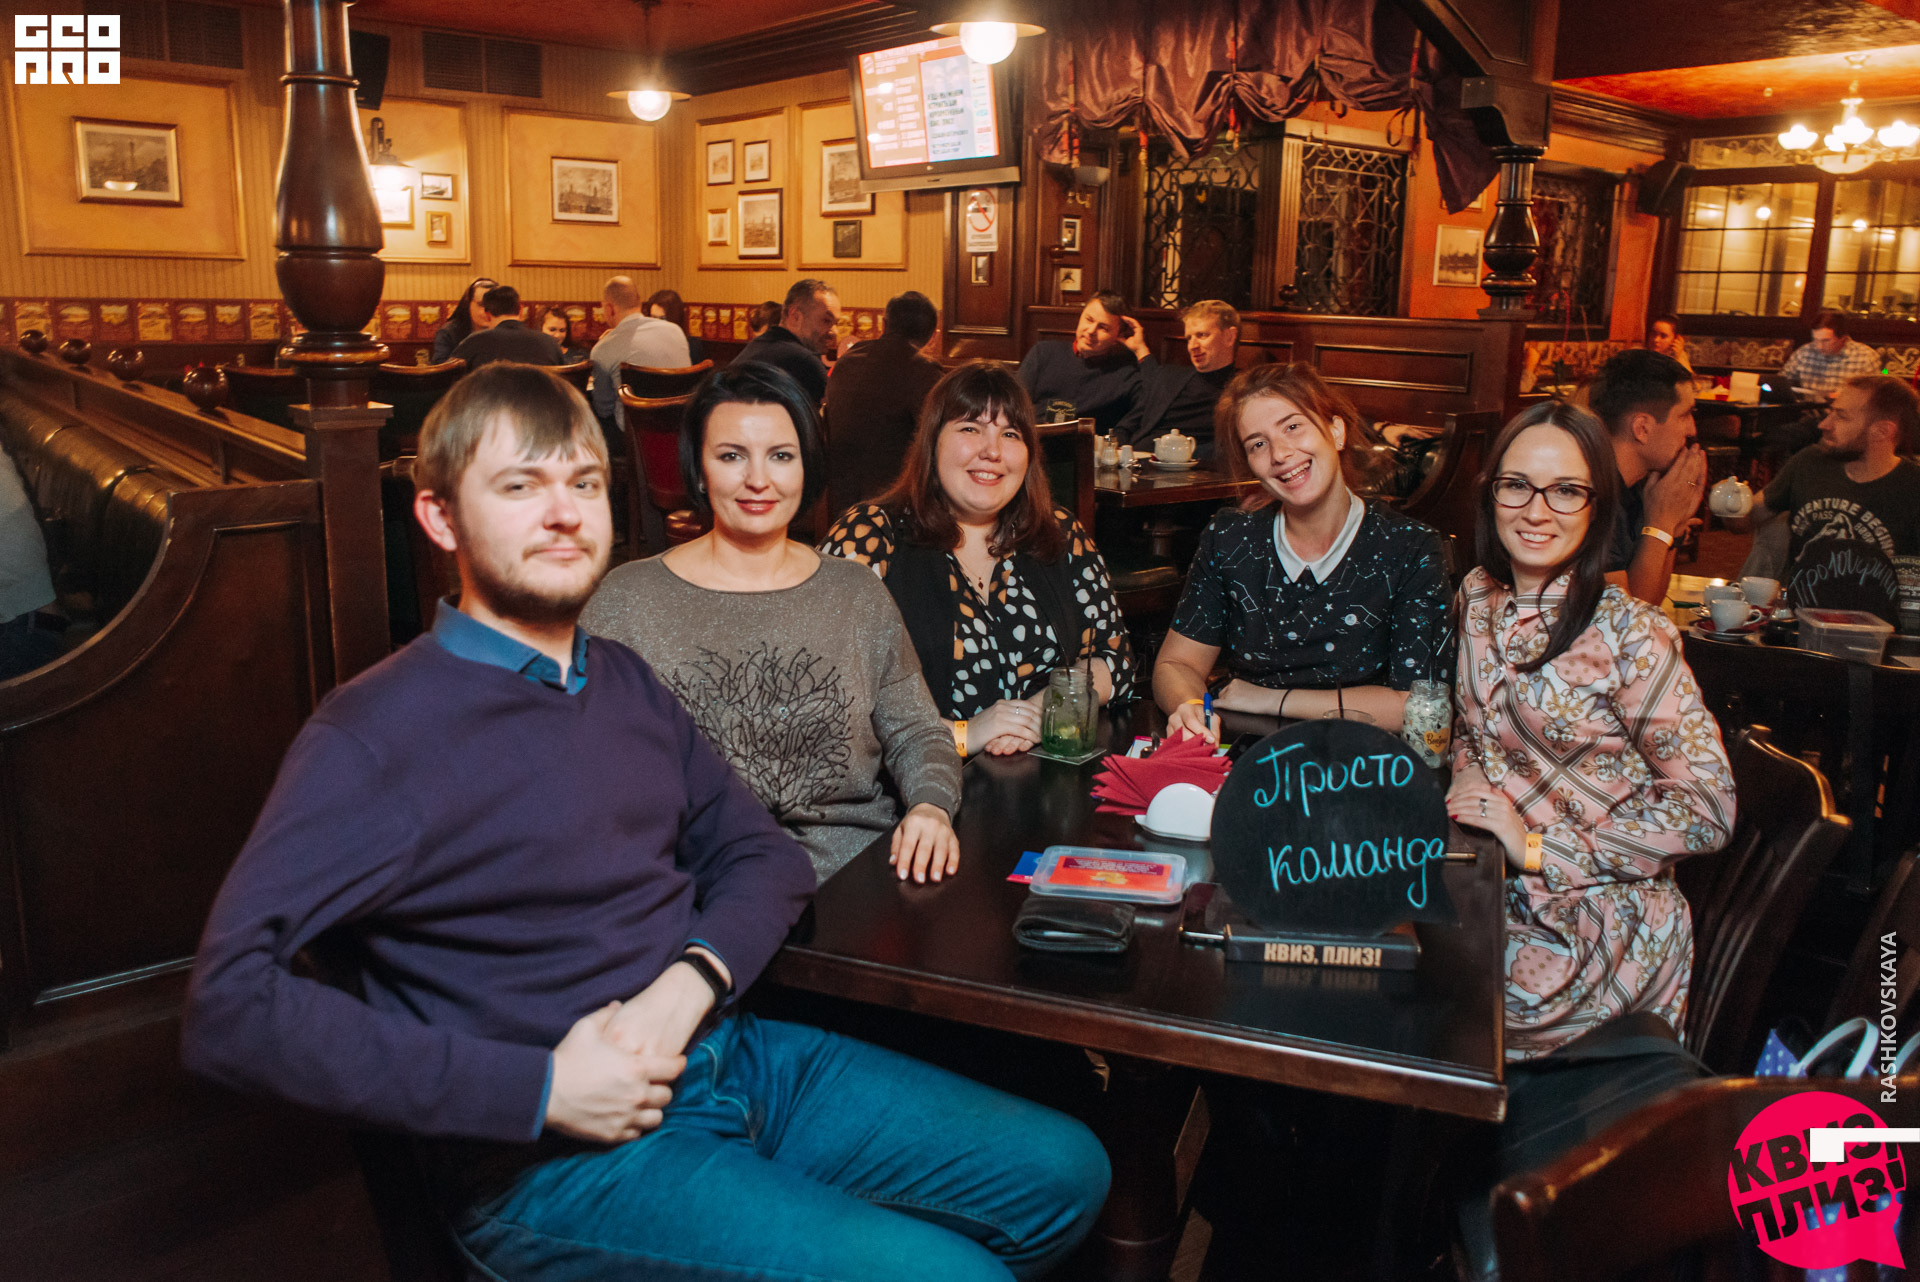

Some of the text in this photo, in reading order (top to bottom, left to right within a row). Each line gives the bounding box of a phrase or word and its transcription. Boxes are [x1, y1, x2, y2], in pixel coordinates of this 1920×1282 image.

[1813, 511, 1834, 521] PASS
[1254, 742, 1414, 817] Просто
[1268, 837, 1446, 908] команда
[1264, 943, 1382, 968] КВИЗ, ПЛИЗ!
